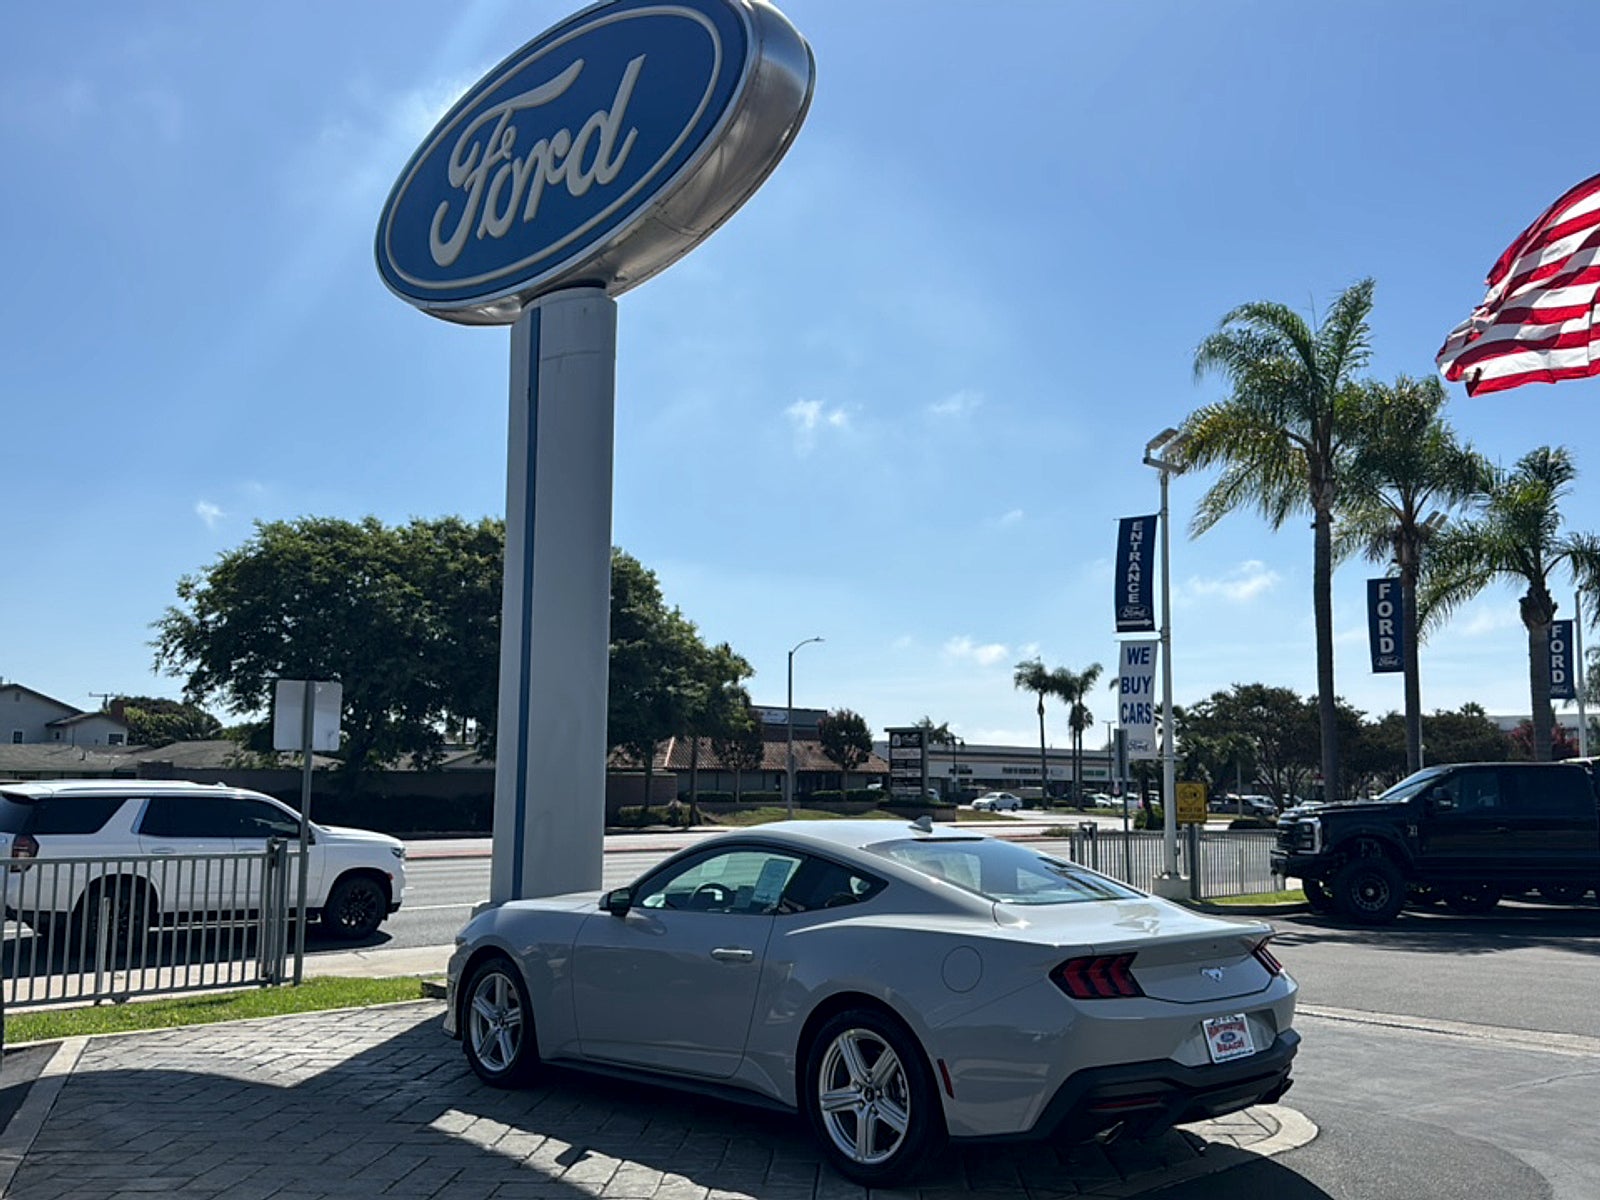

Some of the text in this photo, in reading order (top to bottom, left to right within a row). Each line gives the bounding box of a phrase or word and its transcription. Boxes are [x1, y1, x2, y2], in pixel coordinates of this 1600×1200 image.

[429, 54, 646, 267] Ford
[1127, 521, 1143, 603] ENTRANCE
[1377, 583, 1395, 653] FORD
[1127, 647, 1150, 665] WE
[1551, 625, 1565, 683] FORD
[1121, 676, 1152, 694] BUY
[1121, 703, 1152, 724] CARS
